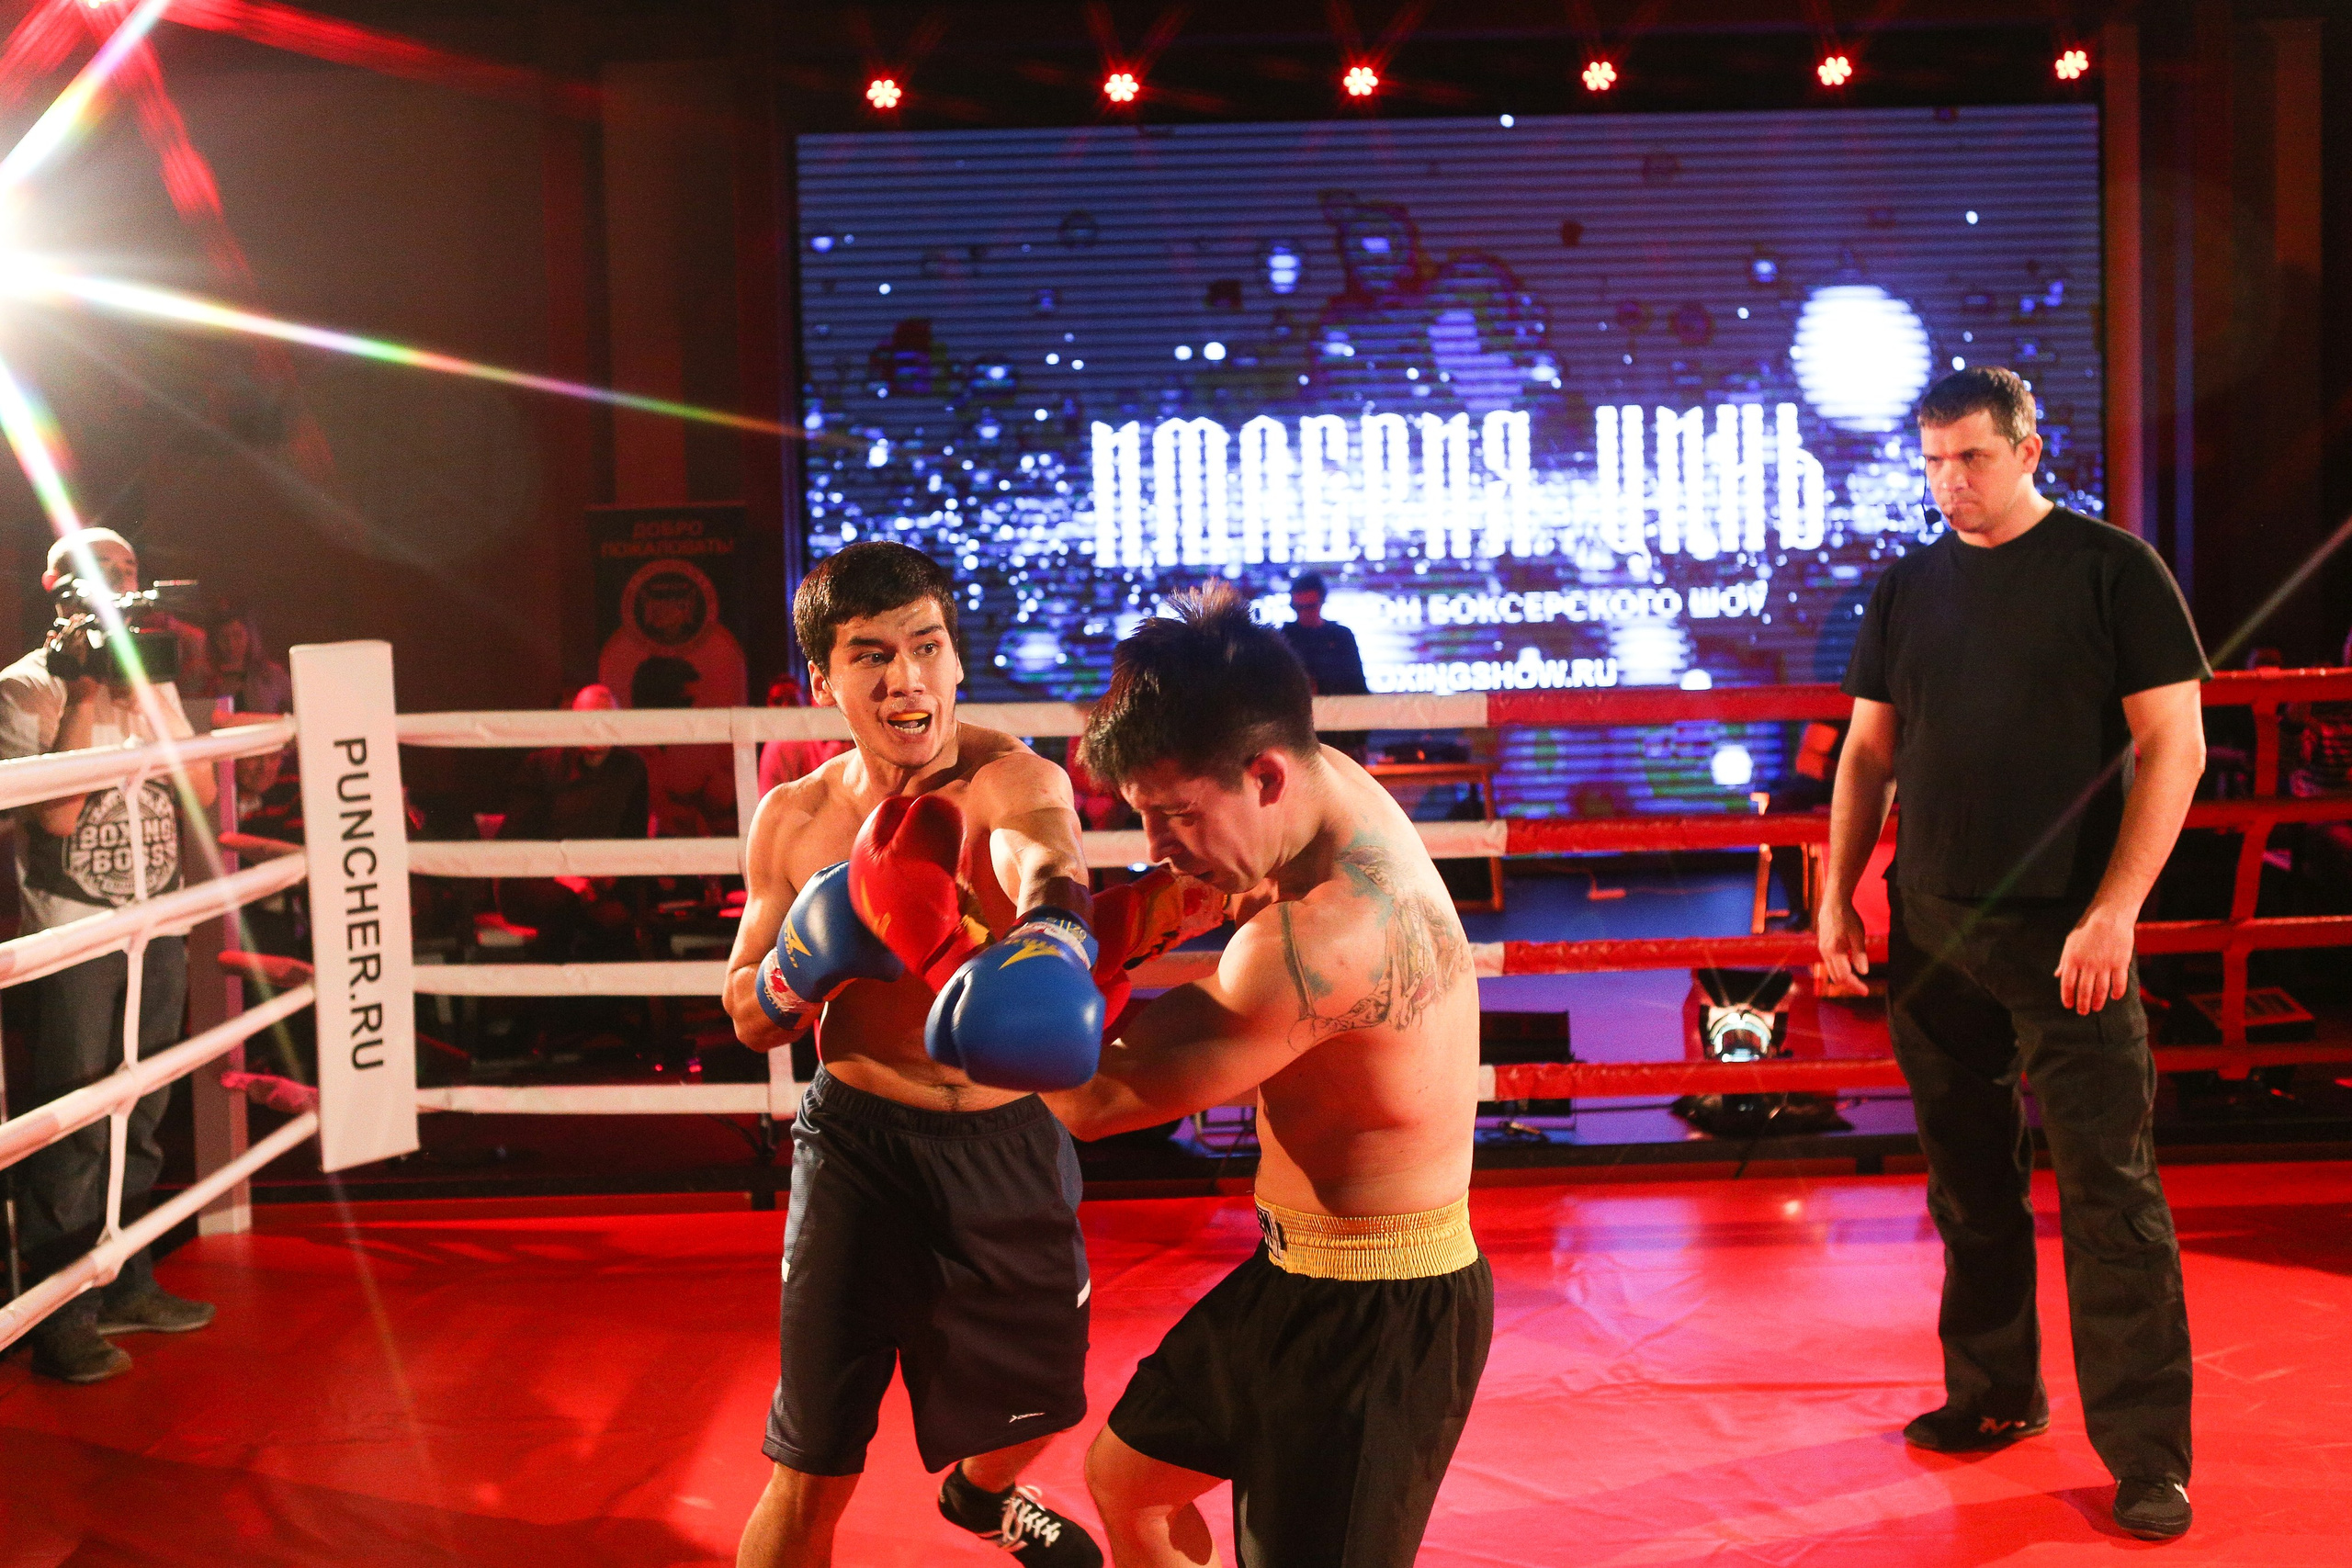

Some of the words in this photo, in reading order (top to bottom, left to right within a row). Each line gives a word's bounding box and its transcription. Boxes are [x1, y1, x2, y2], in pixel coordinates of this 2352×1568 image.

[1595, 401, 1826, 571] ЦИНЬ
[600, 536, 734, 558] ПОЖАЛОВАТЬ!
[632, 520, 704, 539] ДОБРО
[1428, 588, 1682, 626] БОКСЕРСКОГО
[1688, 580, 1769, 619] ШОУ
[79, 817, 172, 850] BOXNG
[333, 737, 384, 1072] PUNCHER.RU
